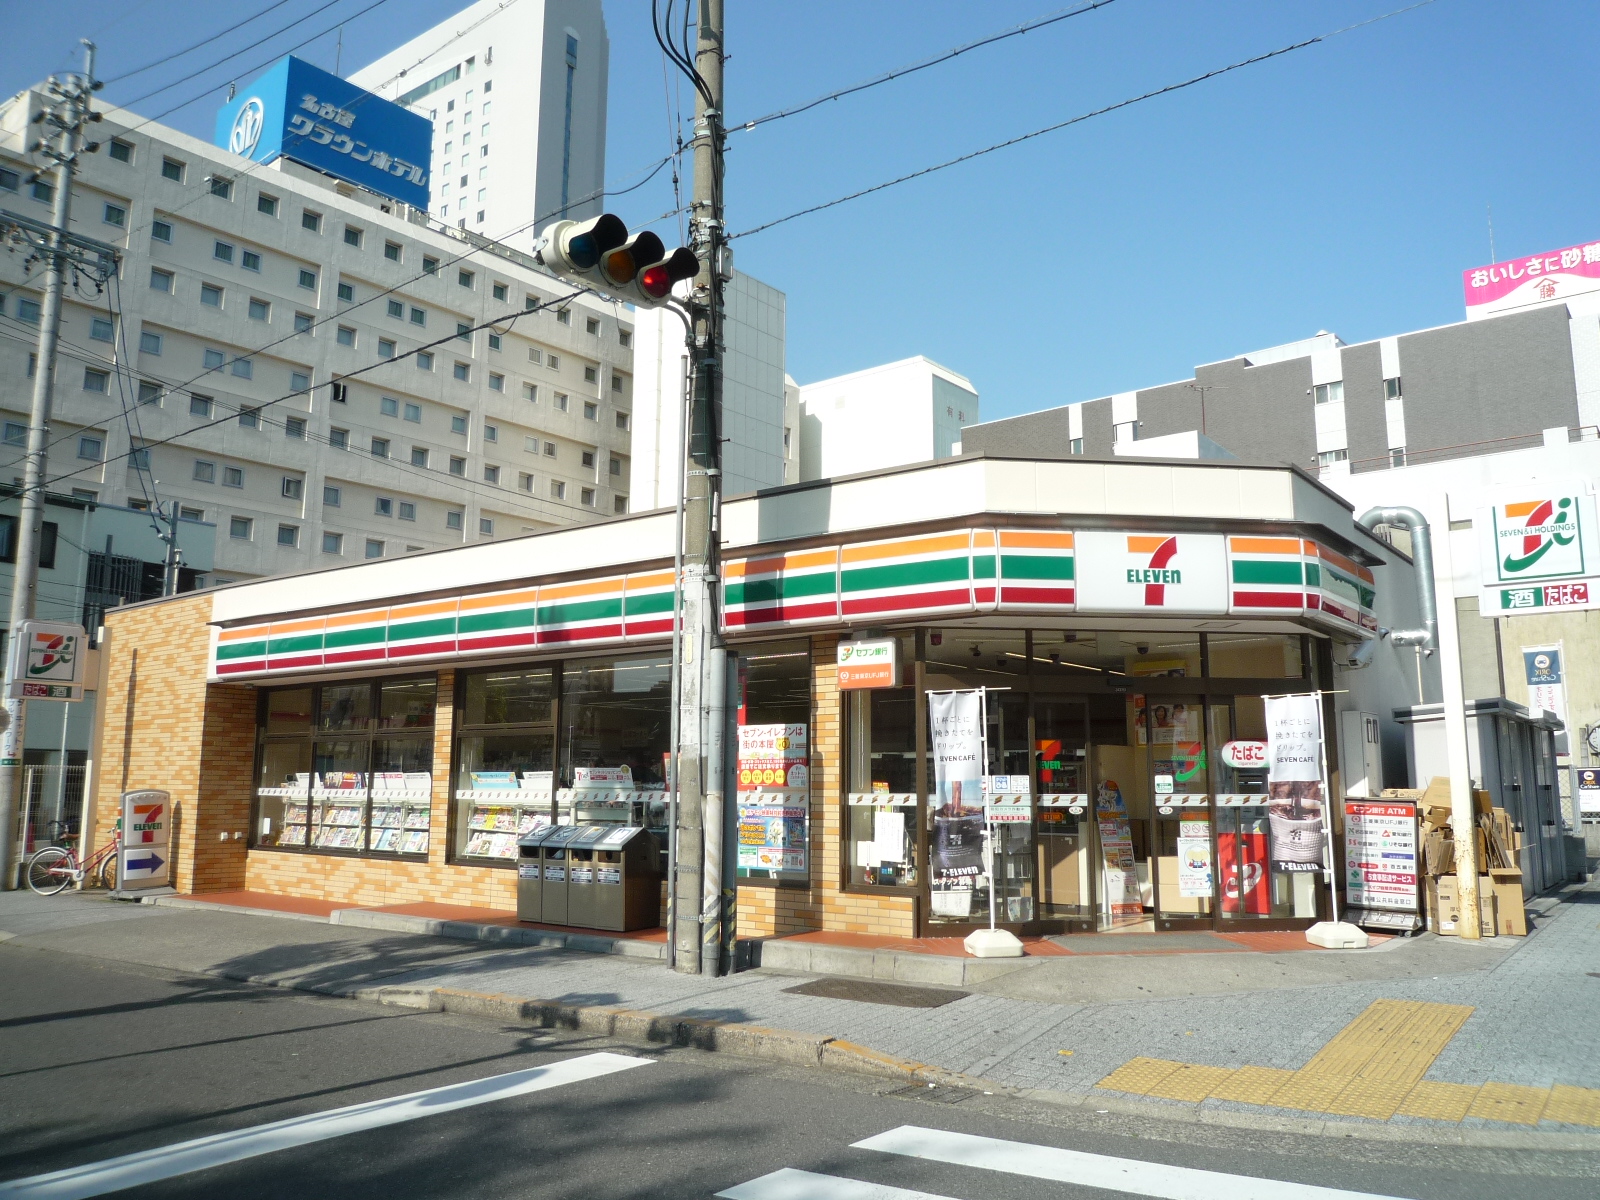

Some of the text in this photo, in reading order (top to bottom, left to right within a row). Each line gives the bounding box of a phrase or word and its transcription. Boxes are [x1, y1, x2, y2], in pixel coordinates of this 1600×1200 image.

[300, 94, 356, 129] 名古屋
[288, 114, 427, 187] クラウンホテル
[1534, 523, 1576, 534] HOLDINGS
[1126, 536, 1178, 606] 7
[1508, 588, 1535, 609] 酒
[1545, 585, 1587, 606] たばこ
[856, 647, 888, 657] セブン銀行
[24, 685, 47, 696] たばこ
[53, 686, 68, 697] 酒
[742, 739, 774, 749] 街の本屋
[1231, 745, 1264, 760] たばこ
[1353, 805, 1385, 815] セブン銀行
